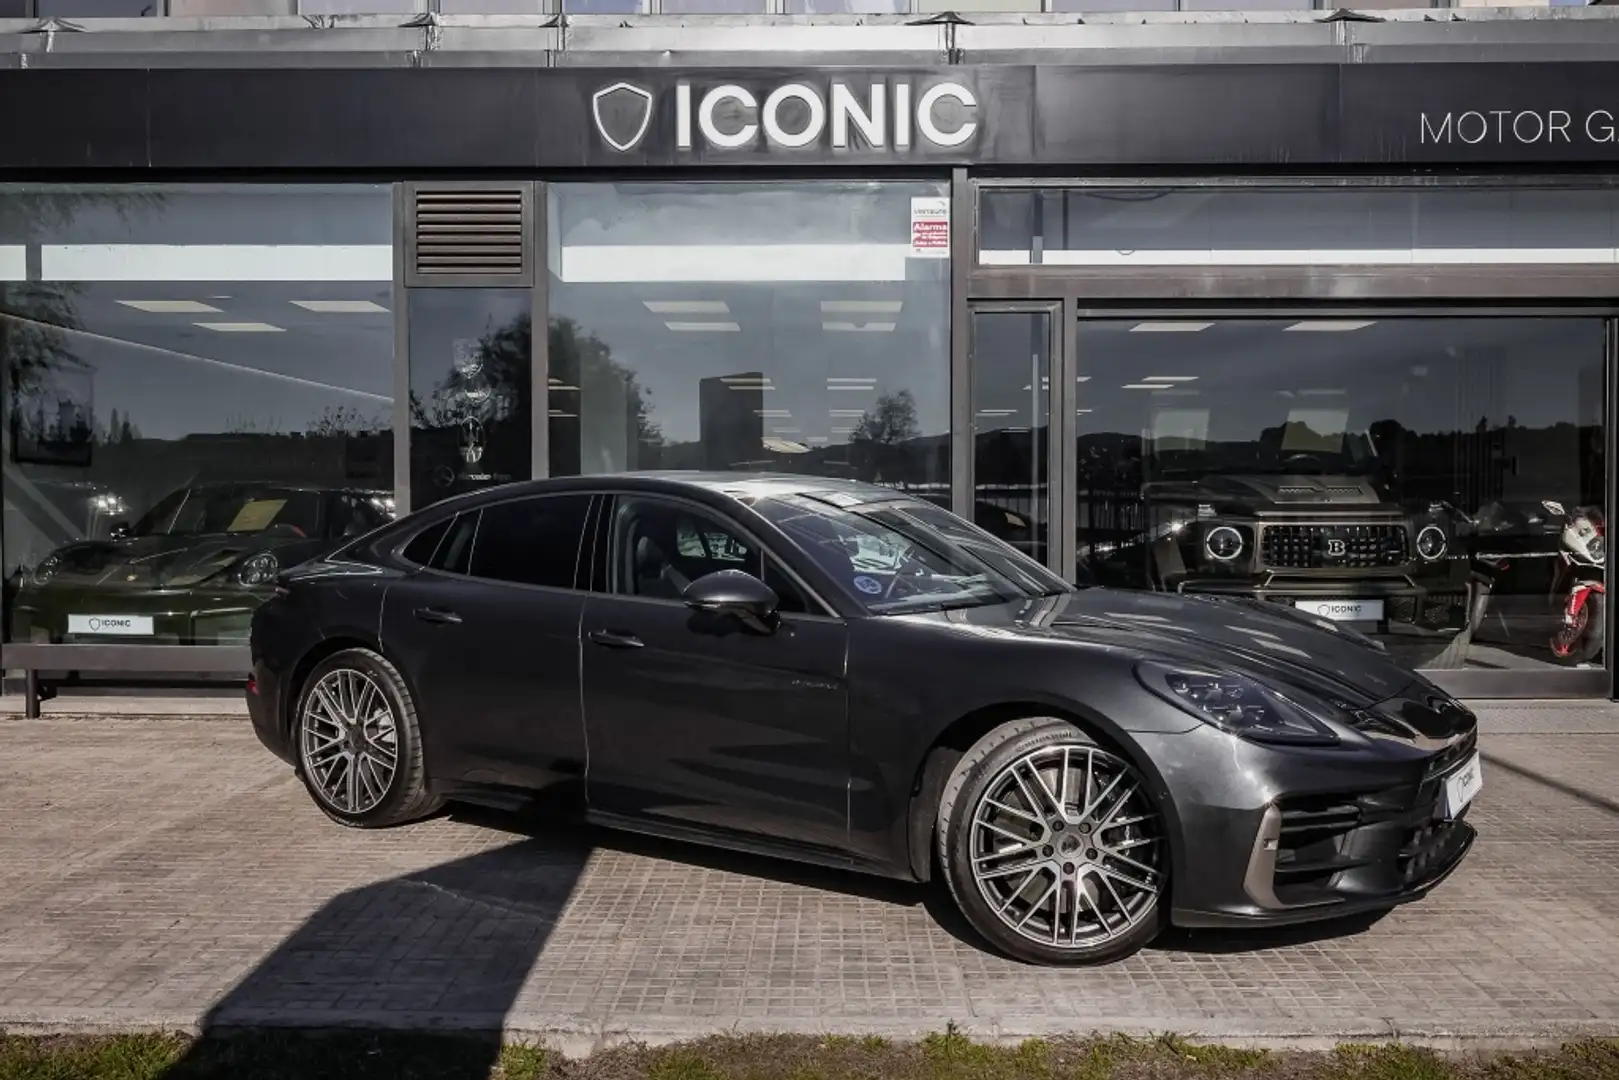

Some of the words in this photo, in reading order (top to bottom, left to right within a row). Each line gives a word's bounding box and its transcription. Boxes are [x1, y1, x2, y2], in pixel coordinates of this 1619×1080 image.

[676, 82, 977, 149] ICONIC
[1420, 110, 1572, 144] MOTOR
[1585, 109, 1619, 143] G
[914, 222, 948, 232] Alarma
